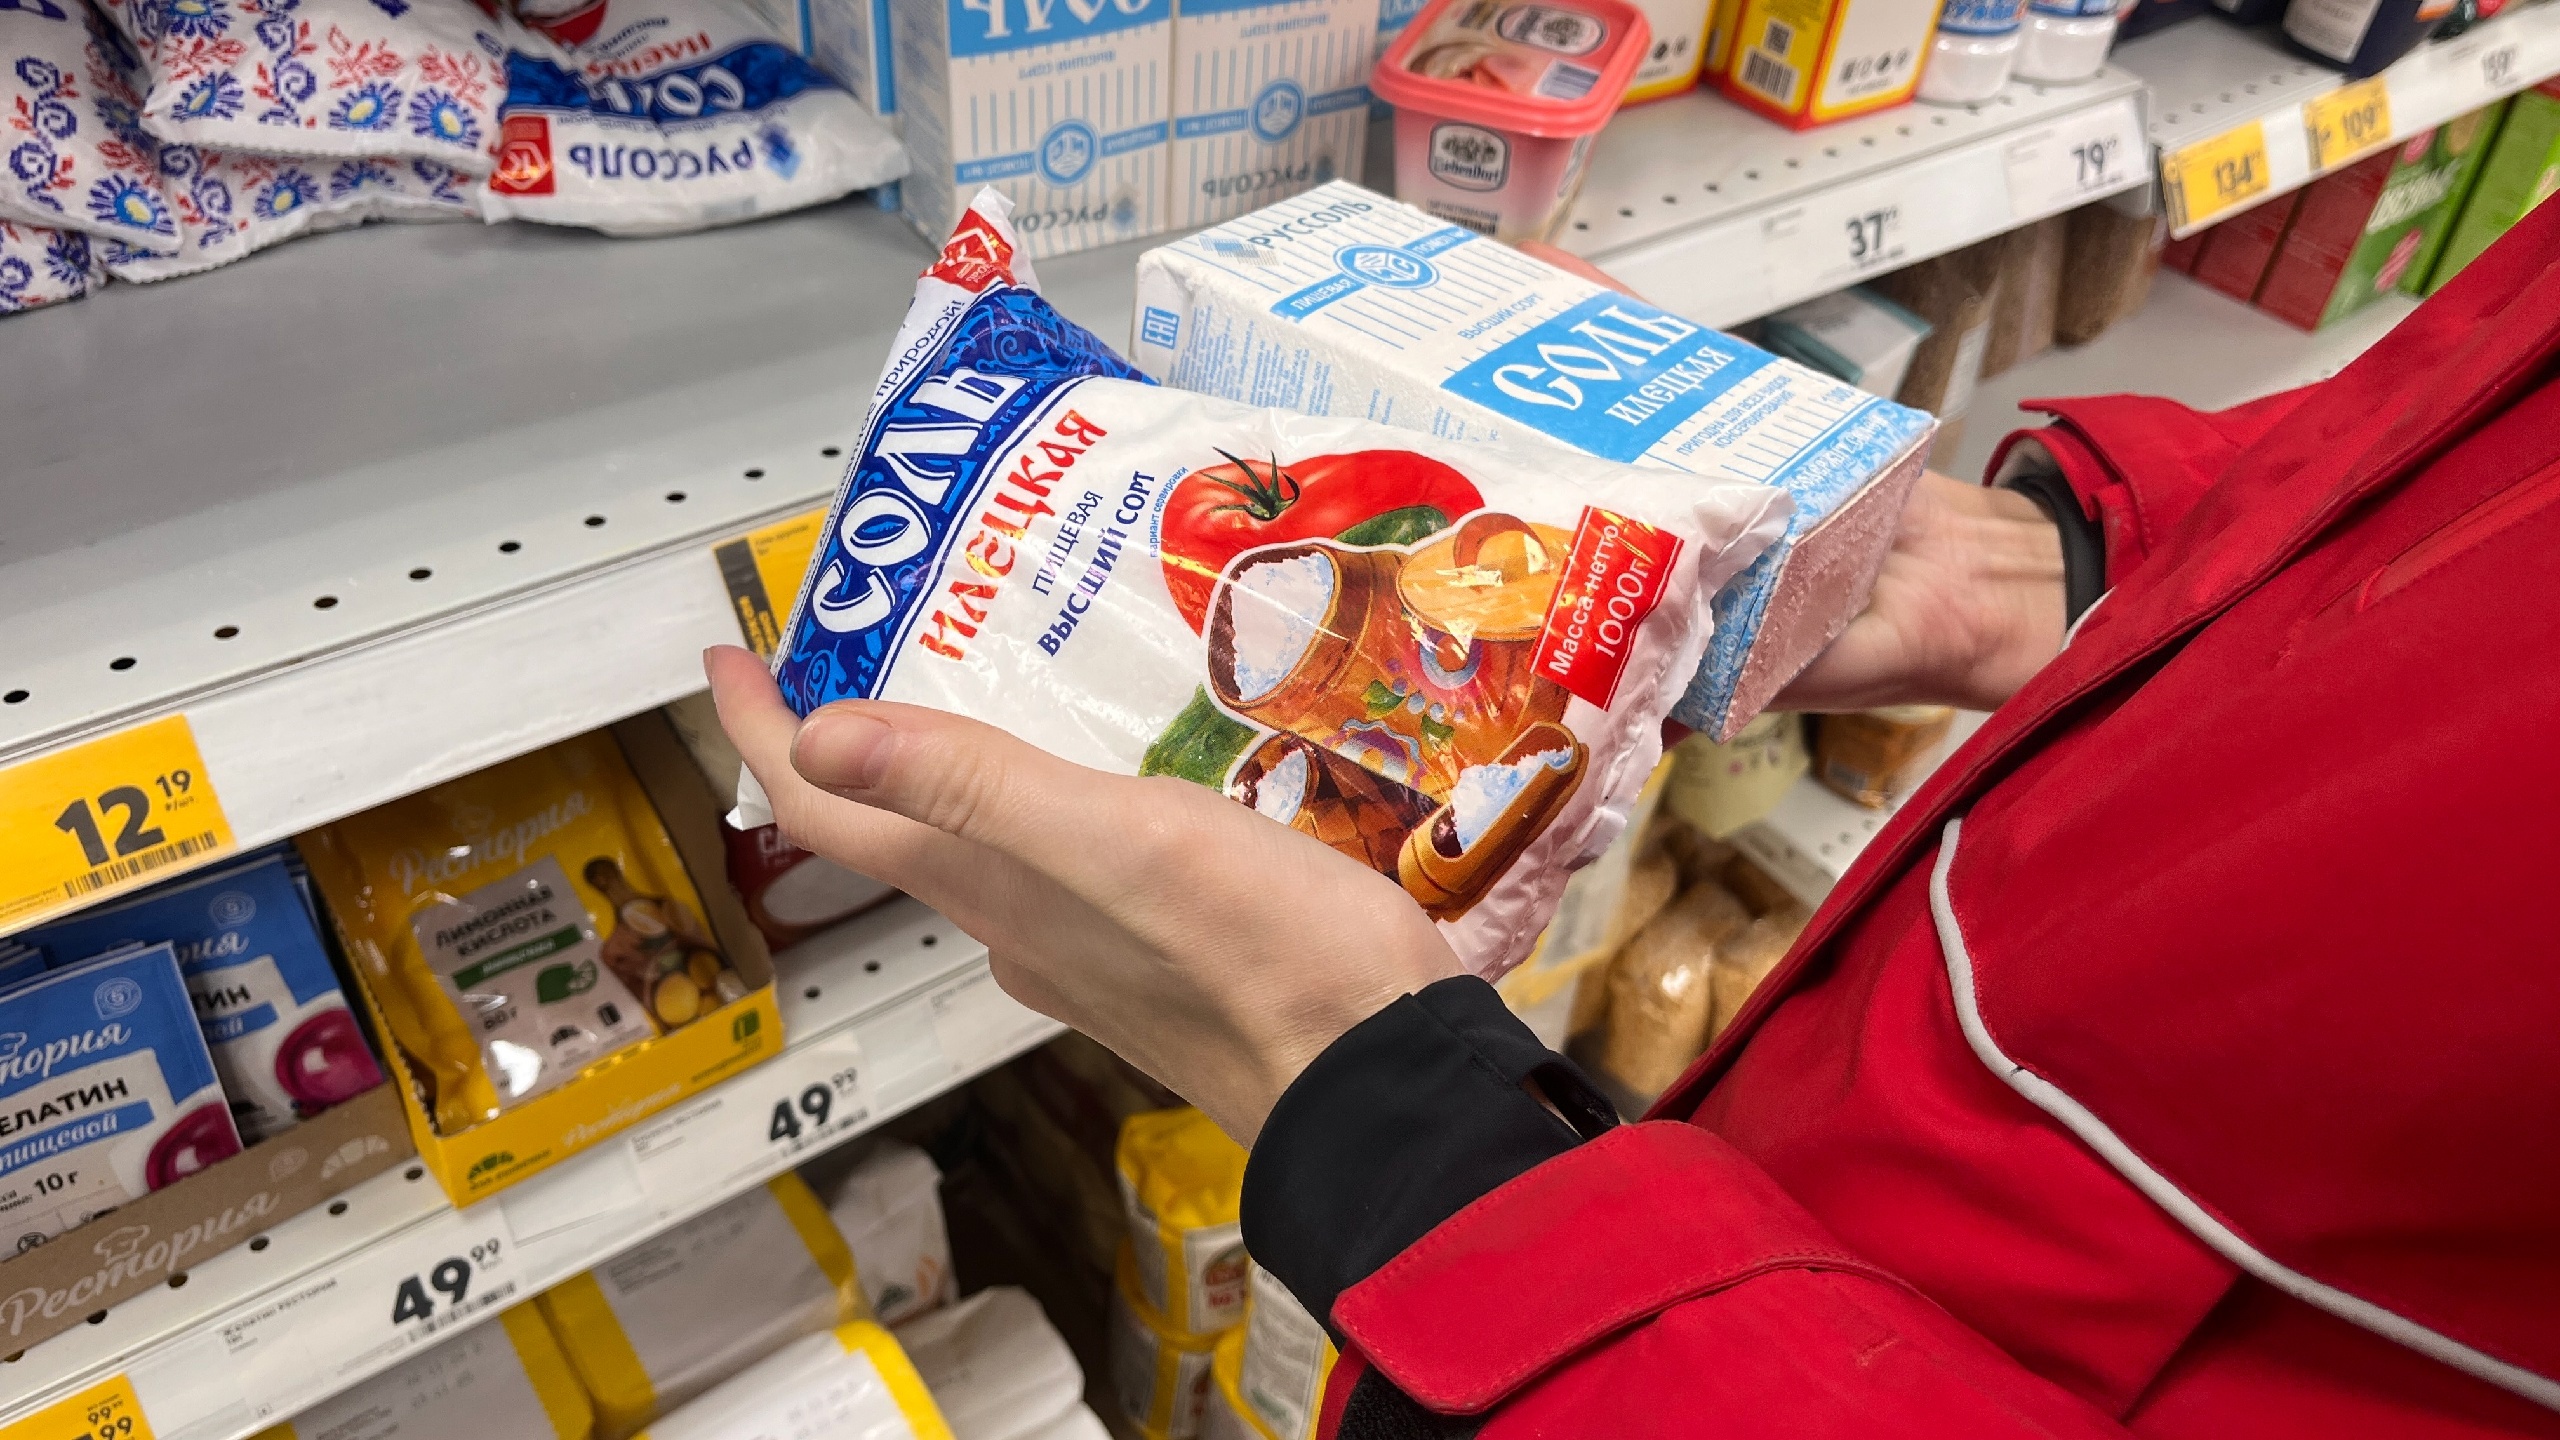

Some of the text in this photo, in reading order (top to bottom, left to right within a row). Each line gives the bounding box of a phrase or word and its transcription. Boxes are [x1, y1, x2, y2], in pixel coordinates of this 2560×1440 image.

[568, 139, 755, 181] РУССОЛЬ
[1202, 162, 1313, 200] РУССОЛЬ
[2071, 141, 2104, 182] 79
[1248, 200, 1374, 249] РУССОЛЬ
[1845, 215, 1887, 259] 37
[1290, 277, 1356, 311] ПИЩЕВАЯ
[1457, 292, 1544, 341] ВЫСШИЙ СОРТ
[876, 299, 964, 397] природой!
[1491, 305, 1699, 411] СОЛЬ
[1604, 346, 1736, 426] ИЛЕЦКАЯ
[1676, 420, 1726, 456] ПРИГОДНА
[812, 367, 1029, 634] СОЛЬ
[1152, 467, 1189, 513] сервировки
[919, 409, 1107, 660] ИЛЕЦКАЯ
[1032, 489, 1103, 596] ПИЩЕВАЯ
[1037, 471, 1155, 656] ВЫСШИЙ СОРТ
[1549, 524, 1619, 675] Масса нетто
[55, 768, 192, 867] 12 19
[389, 790, 594, 895] Рестория
[434, 886, 553, 948] ЛИМОННАЯ
[458, 908, 557, 958] КИСЛОТА
[769, 1084, 832, 1143] 49
[832, 1067, 858, 1090] 99
[34, 1171, 79, 1196] 10 г
[5, 1191, 280, 1336] Рестория
[393, 1238, 500, 1326] 49 99
[88, 1405, 111, 1425] 99
